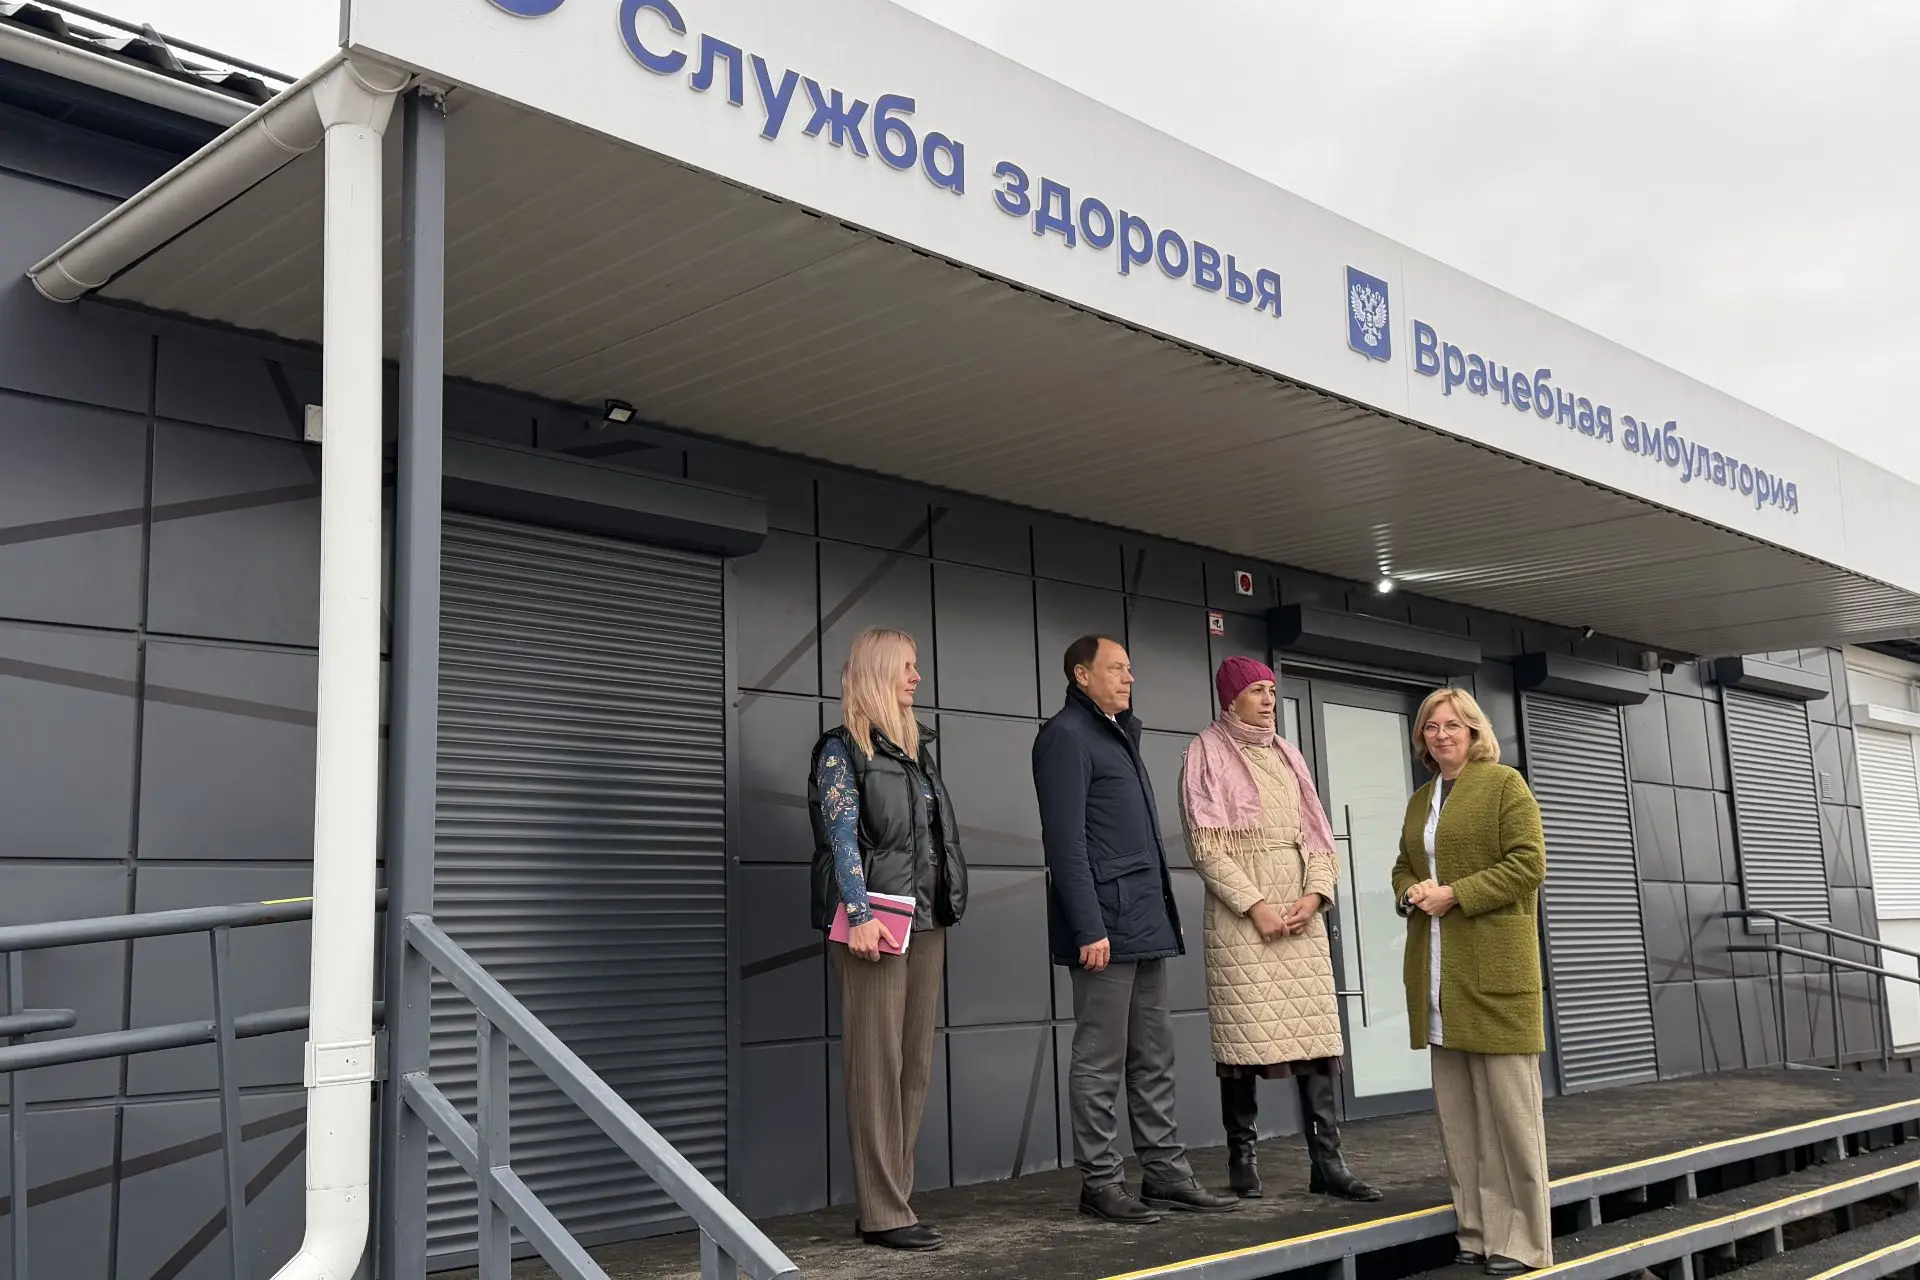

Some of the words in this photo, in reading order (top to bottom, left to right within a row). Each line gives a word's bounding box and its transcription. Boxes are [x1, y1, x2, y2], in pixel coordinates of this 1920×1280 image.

[617, 0, 966, 196] Служба
[992, 160, 1282, 318] здоровья
[1411, 319, 1614, 443] Врачебная
[1620, 415, 1799, 514] амбулатория
